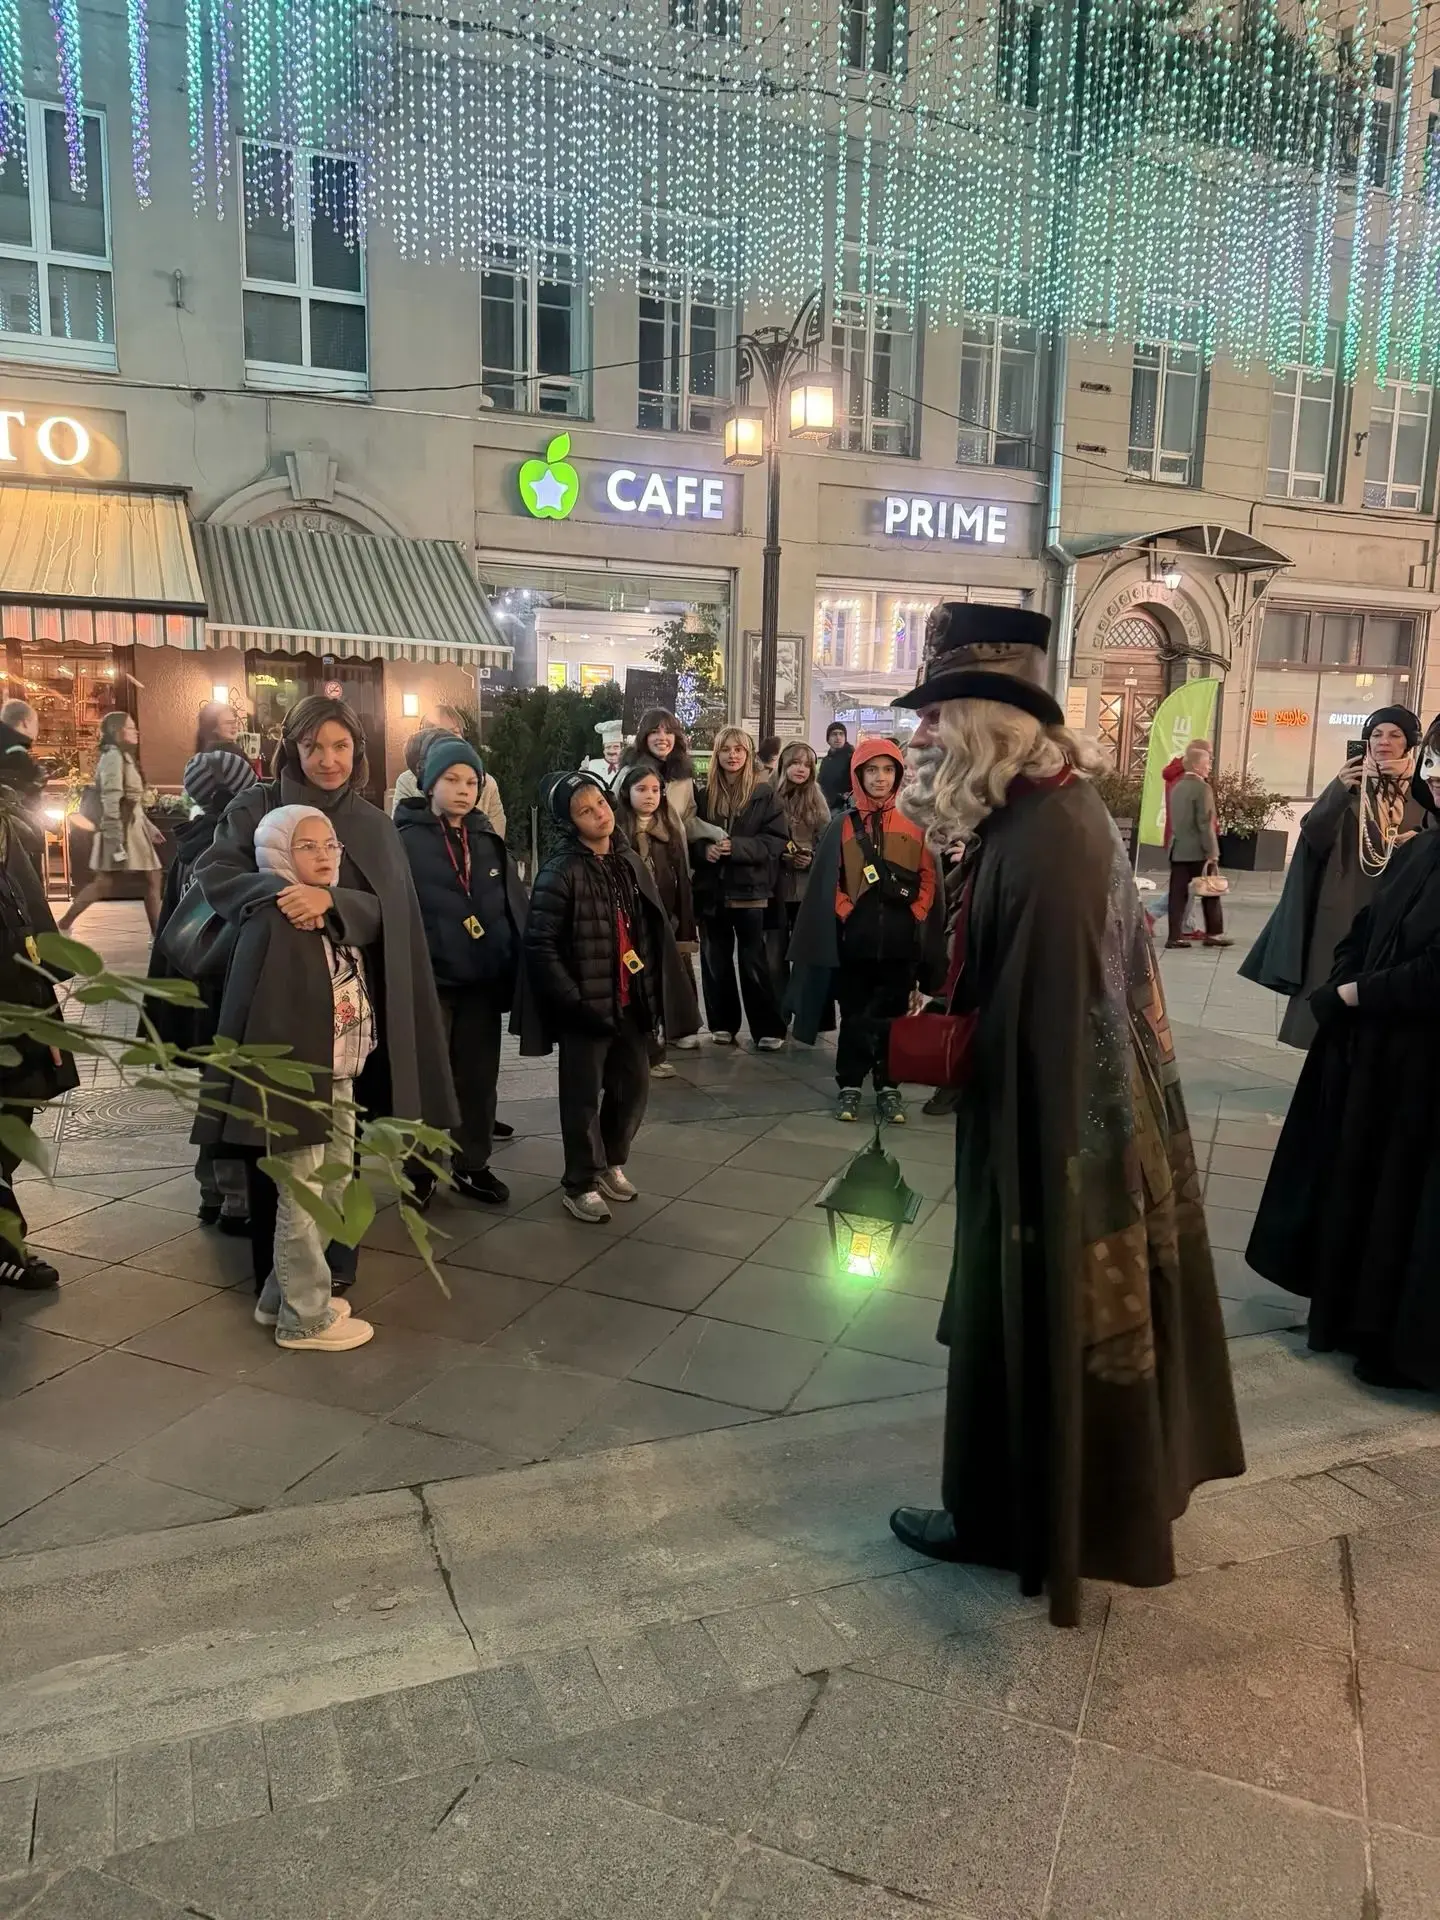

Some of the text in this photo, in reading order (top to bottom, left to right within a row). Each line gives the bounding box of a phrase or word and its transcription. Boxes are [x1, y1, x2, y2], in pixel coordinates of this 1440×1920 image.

[606, 469, 724, 520] CAFE
[885, 496, 1008, 544] PRIME
[1128, 666, 1135, 675] 2
